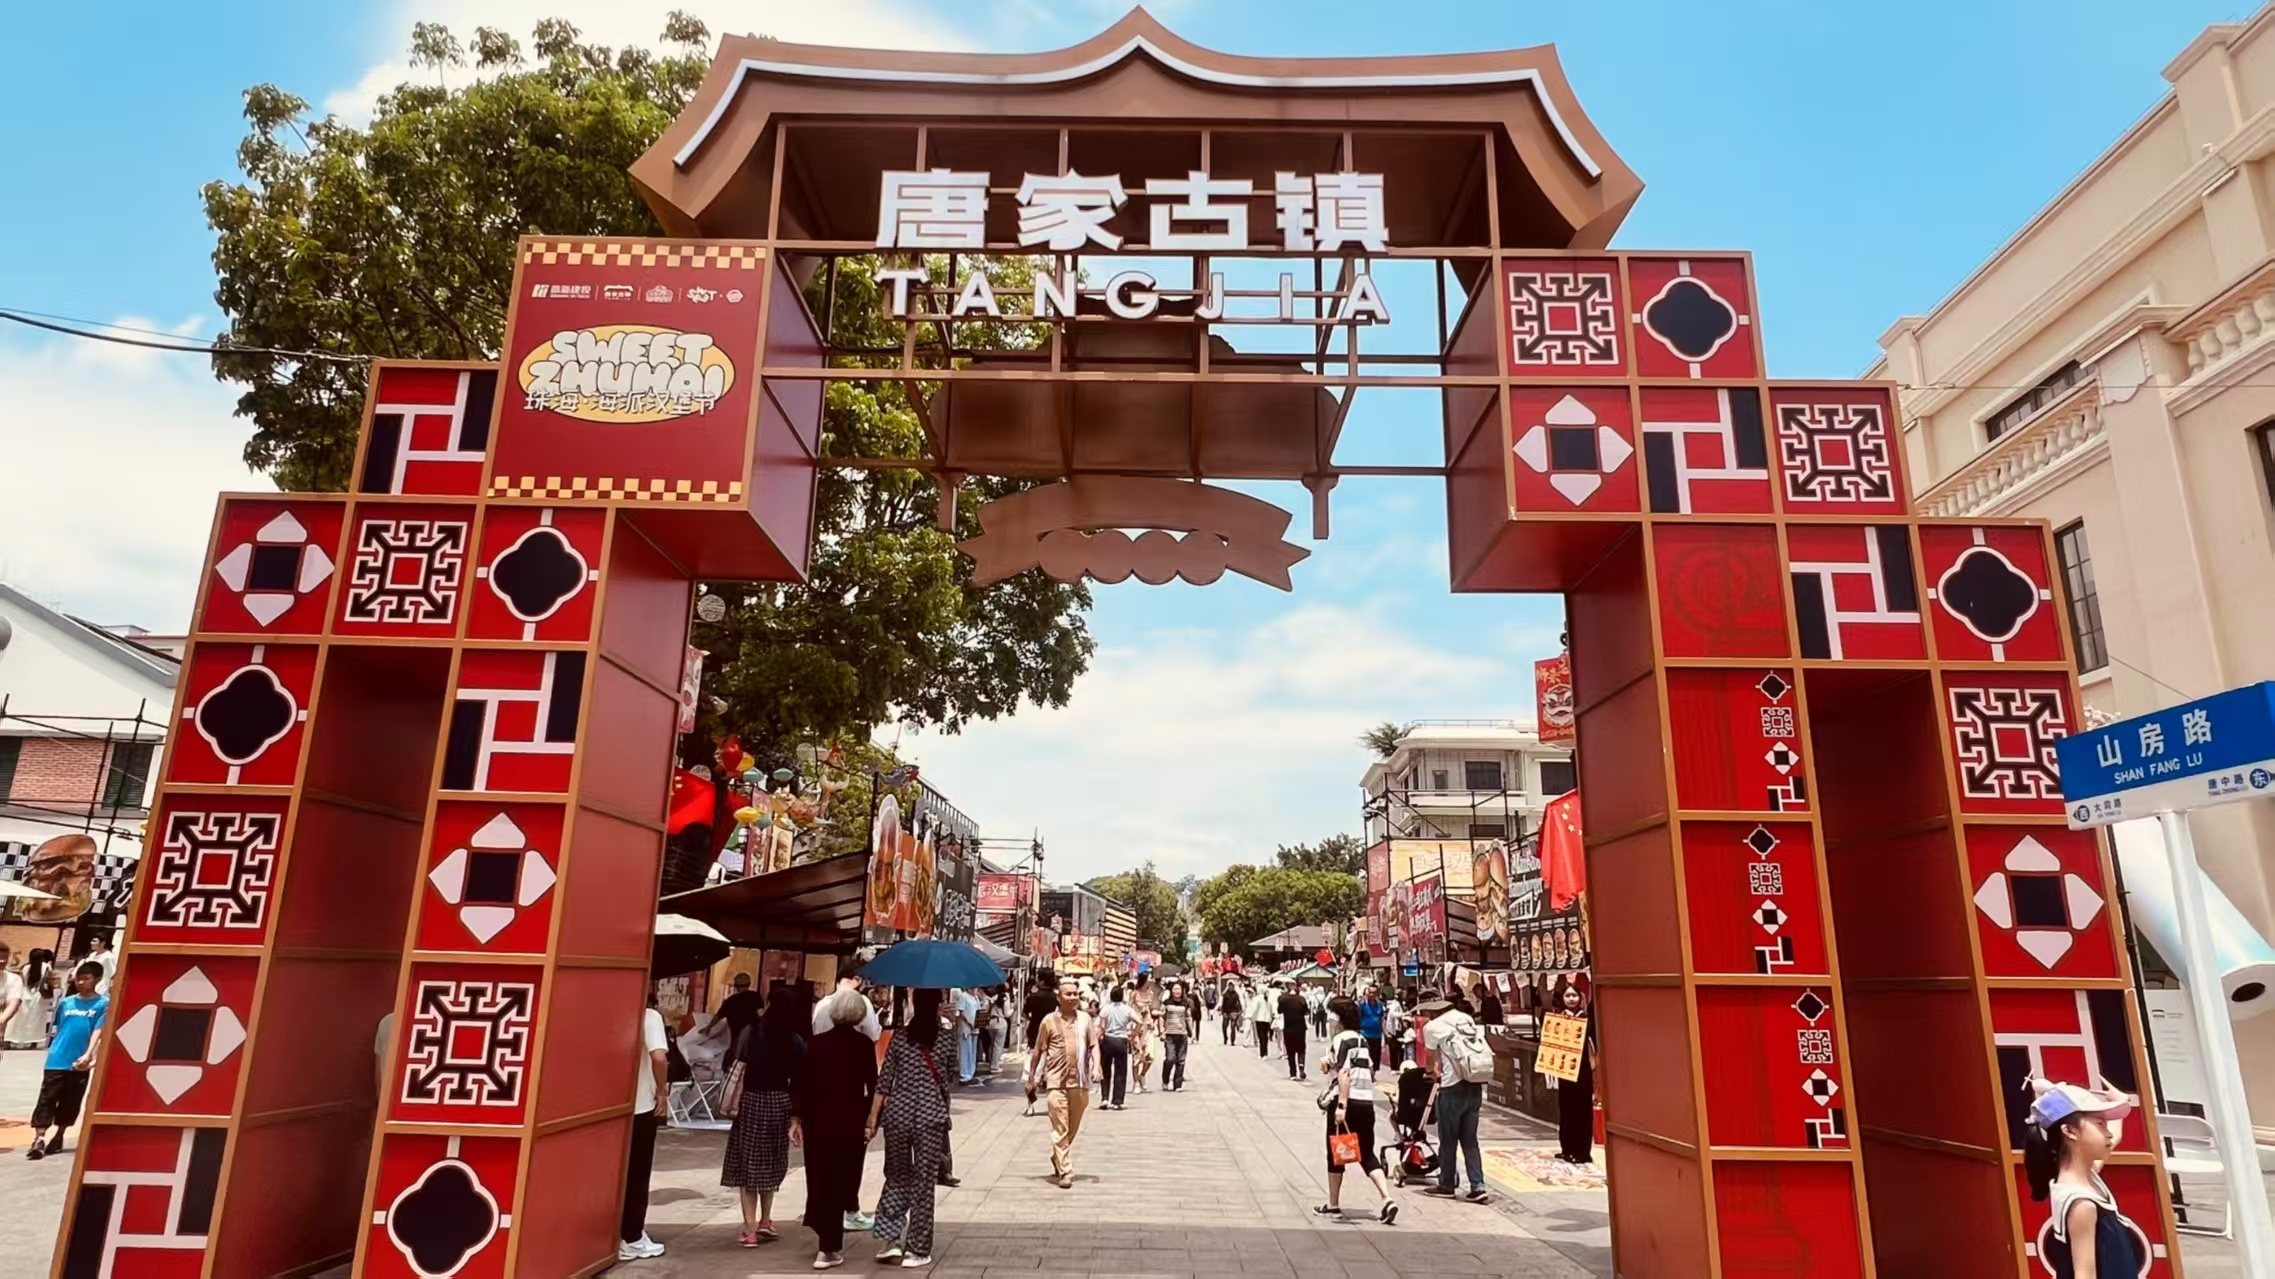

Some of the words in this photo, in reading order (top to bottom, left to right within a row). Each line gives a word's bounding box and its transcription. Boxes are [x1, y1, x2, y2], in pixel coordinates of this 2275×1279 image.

[876, 168, 1390, 252] 唐家古镇
[549, 330, 714, 369] SWEET
[527, 360, 726, 399] ZHUHAI
[523, 388, 716, 416] 珠海·海派汉堡节
[2097, 709, 2212, 767] 山房路
[2114, 767, 2144, 784] SHAN
[2149, 758, 2180, 776] FANG
[2186, 752, 2202, 767] LU
